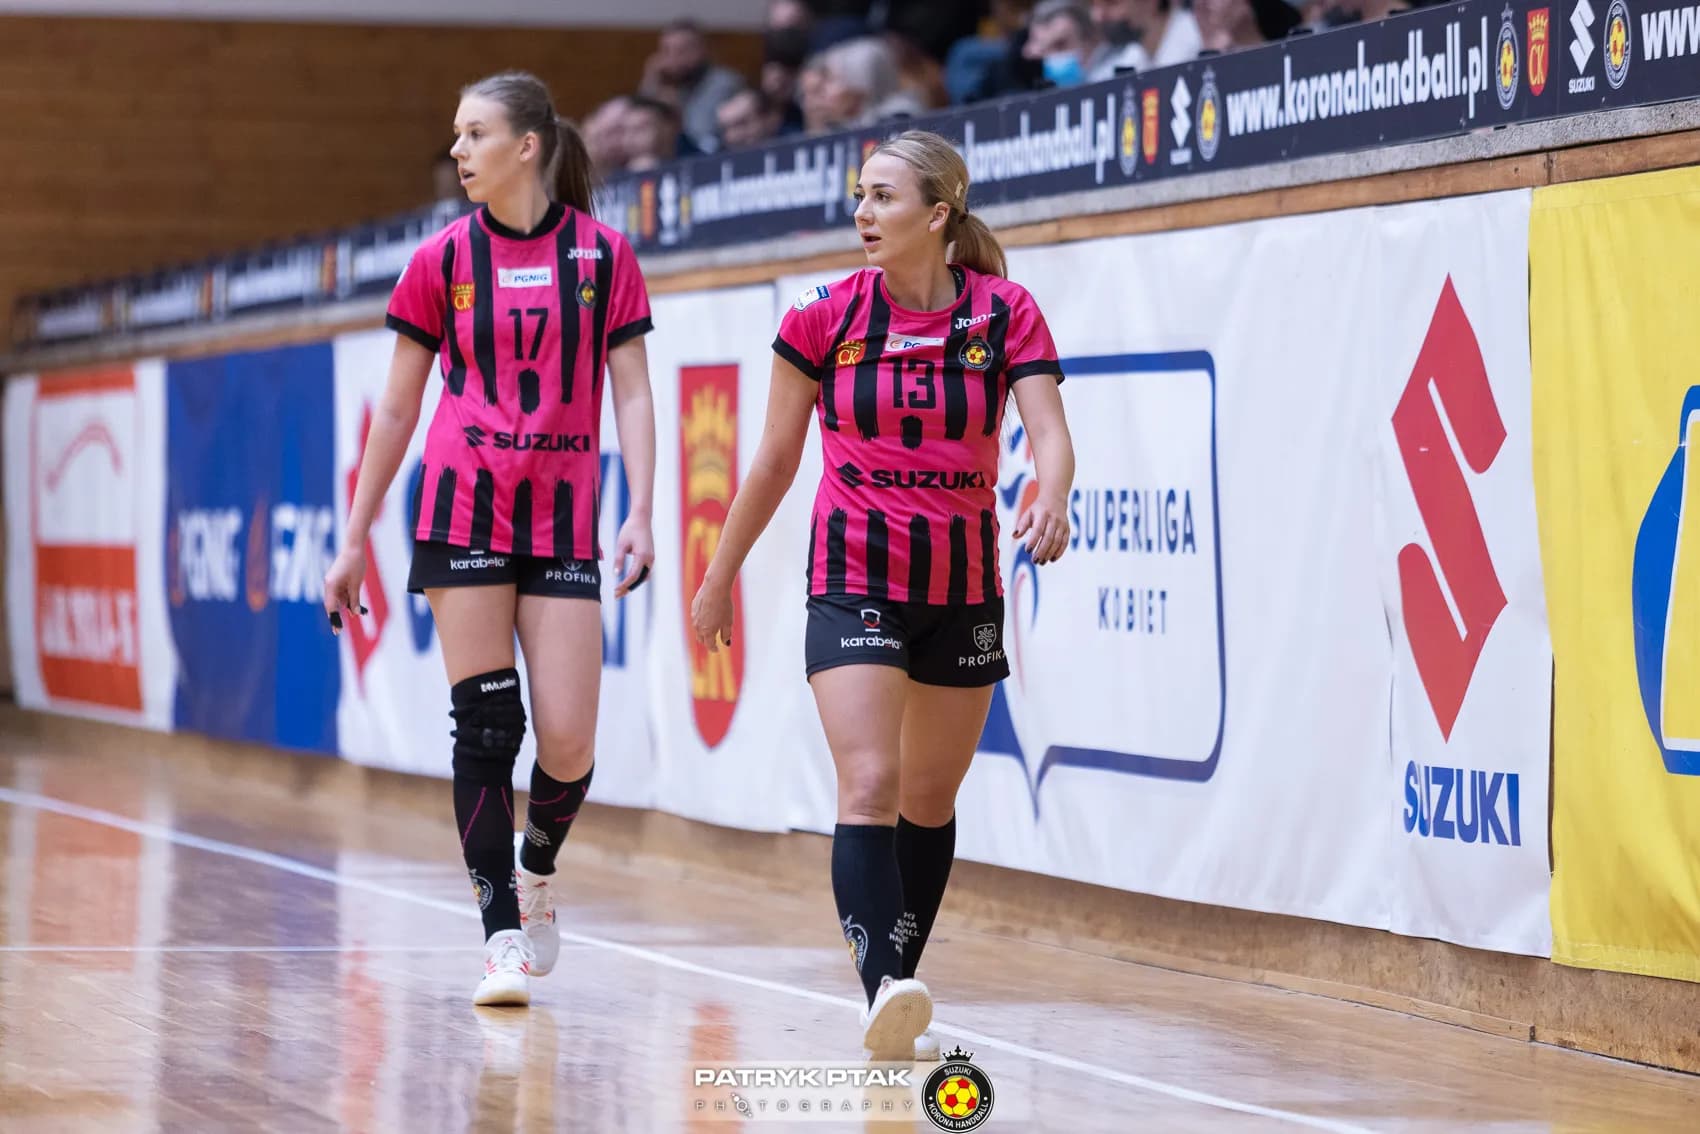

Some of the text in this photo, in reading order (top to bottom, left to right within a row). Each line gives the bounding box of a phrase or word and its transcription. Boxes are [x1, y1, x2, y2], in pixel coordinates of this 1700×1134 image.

[1226, 16, 1489, 137] www.koronahandball.pl
[1568, 76, 1595, 94] SUZUKI
[508, 308, 549, 361] 17
[838, 349, 859, 365] CK
[888, 357, 937, 410] 13
[493, 431, 590, 453] SUZUKI
[871, 469, 986, 490] SUZUKI
[1070, 488, 1196, 555] SUPERLIGA
[545, 570, 597, 585] PROFIKA
[1098, 586, 1167, 635] KOBIET
[1403, 760, 1522, 847] SUZUKI
